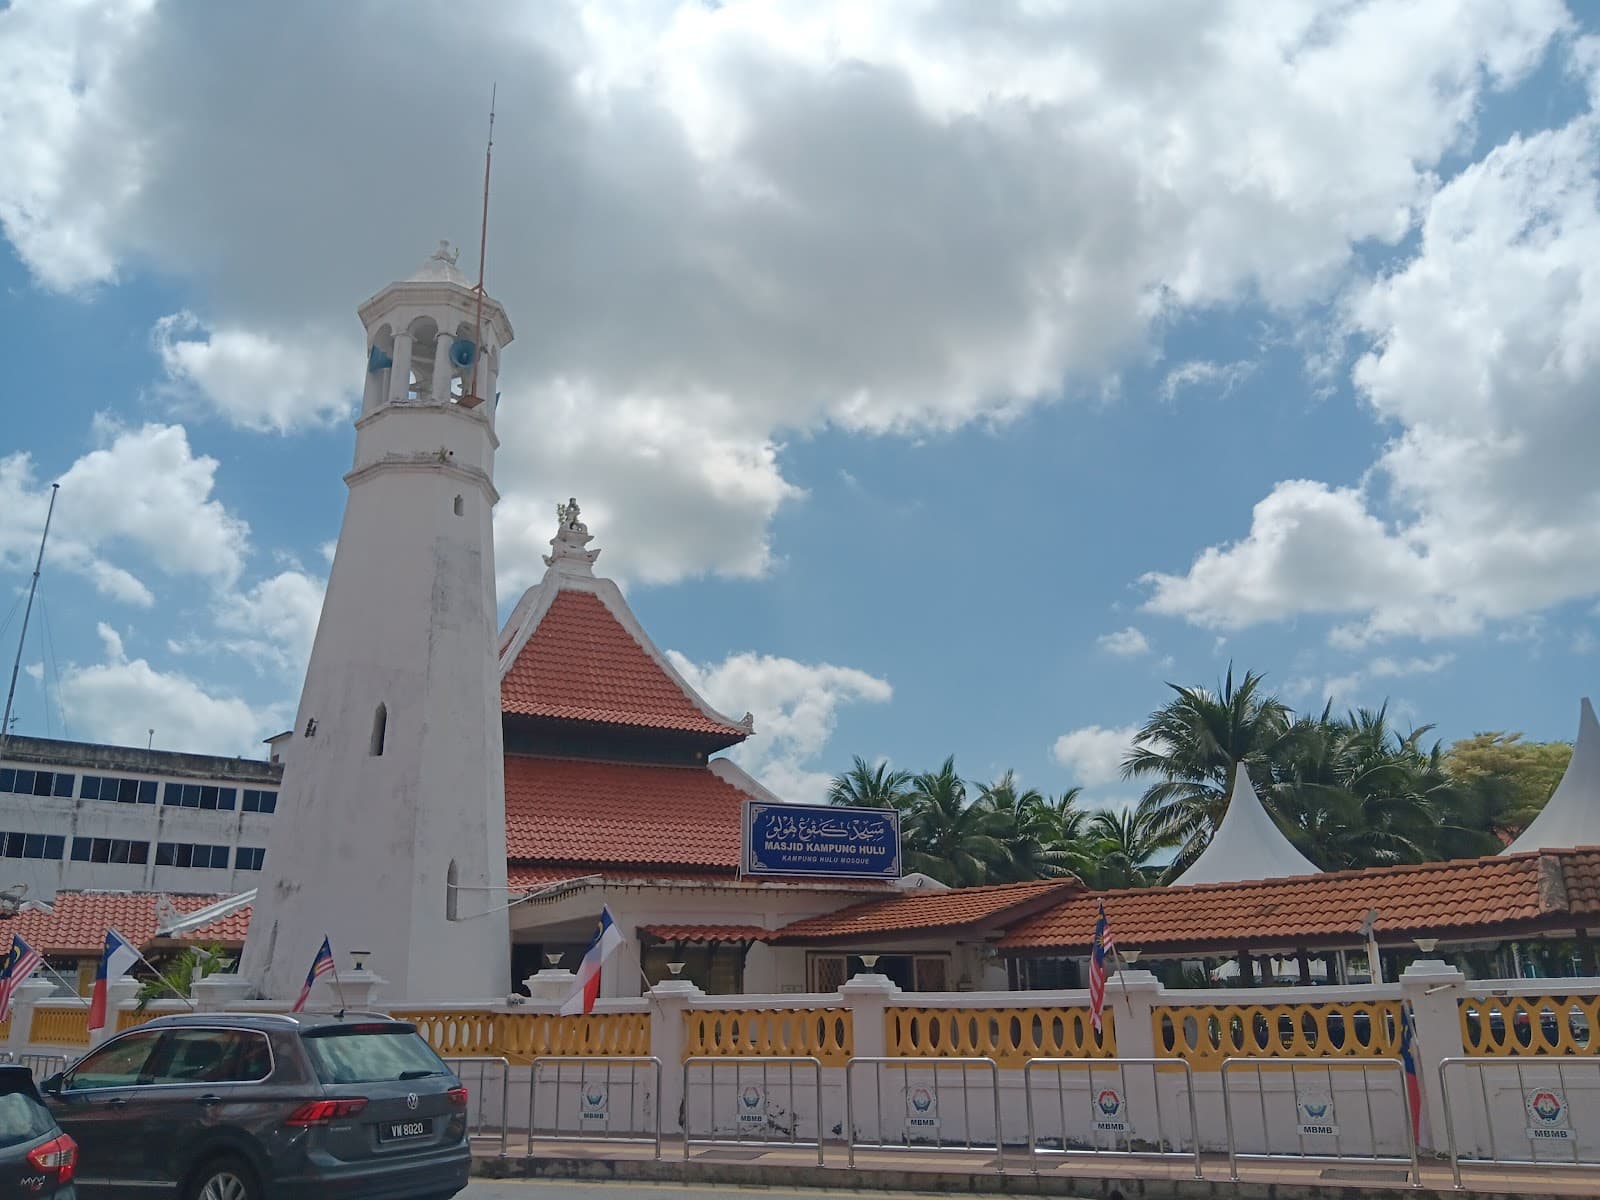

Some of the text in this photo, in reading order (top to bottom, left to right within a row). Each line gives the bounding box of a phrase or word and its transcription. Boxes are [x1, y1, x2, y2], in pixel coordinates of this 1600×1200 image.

[764, 841, 886, 855] MASJID KAMPUNG HULU
[840, 857, 870, 865] MOSQUE
[403, 1122, 424, 1136] 8020
[1097, 1123, 1124, 1131] MBMB
[1303, 1126, 1333, 1134] MBMB
[1534, 1130, 1568, 1138] MBMB
